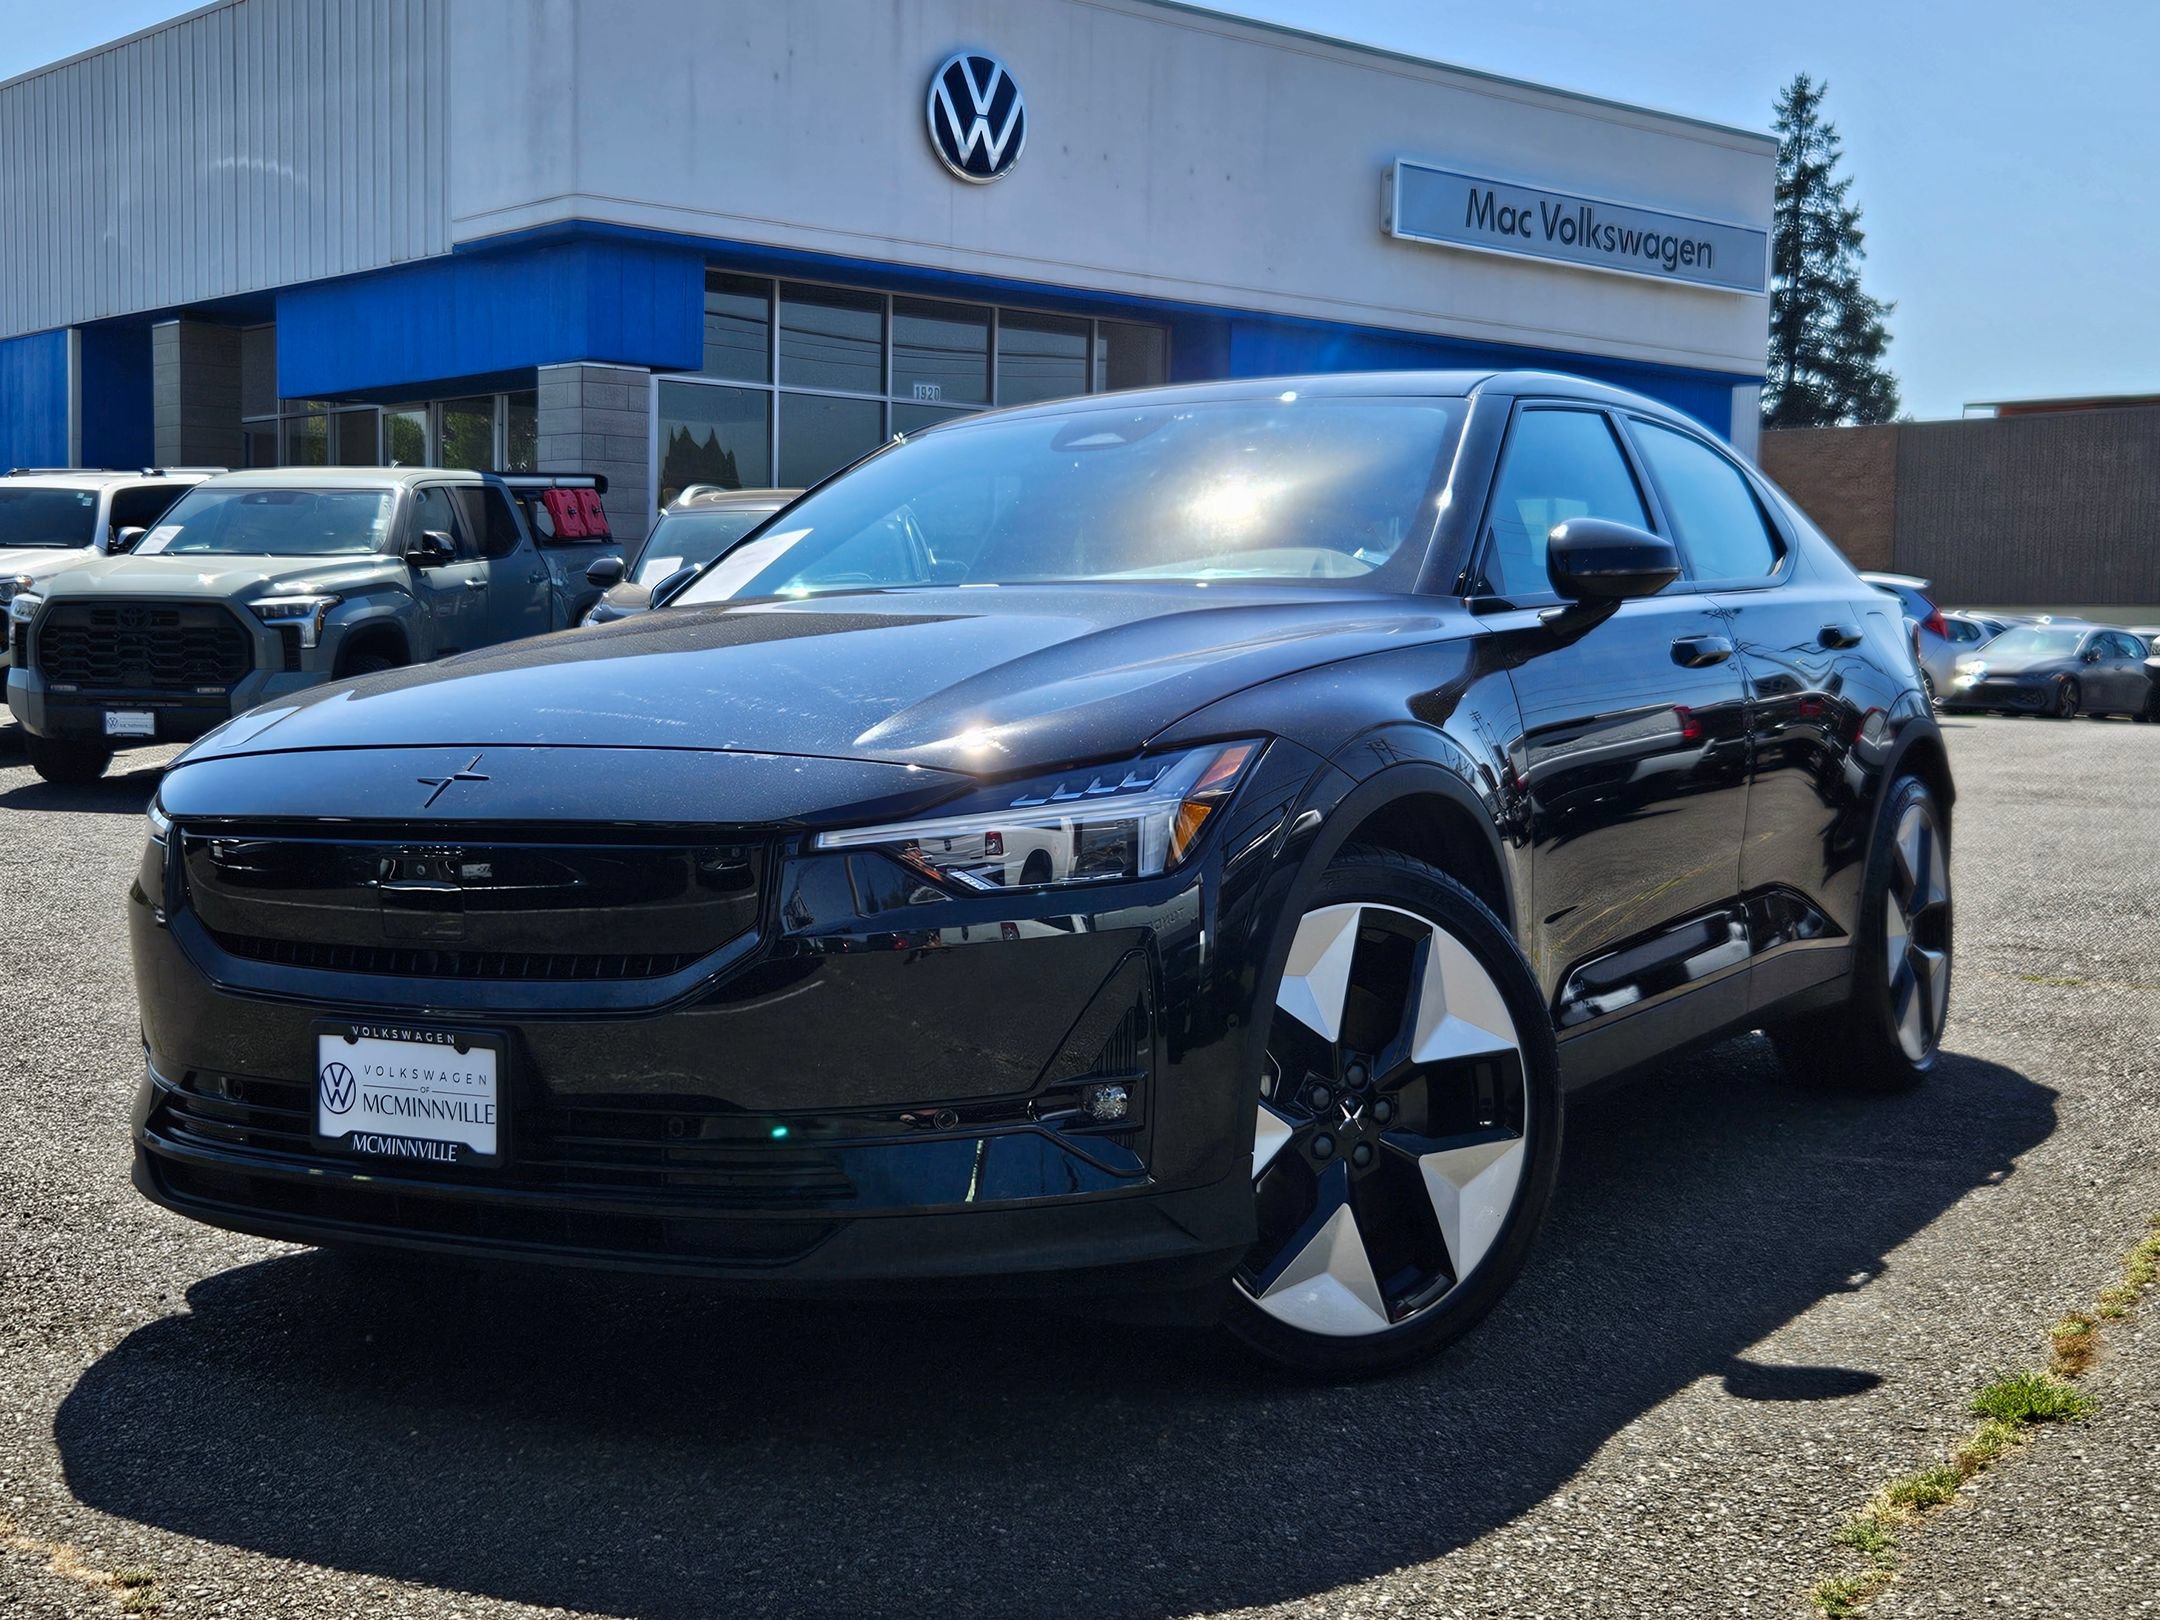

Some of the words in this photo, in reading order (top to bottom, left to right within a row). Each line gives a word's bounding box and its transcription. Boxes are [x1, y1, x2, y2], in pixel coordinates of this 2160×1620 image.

[930, 53, 1026, 183] VW
[1464, 187, 1532, 239] Mac
[1539, 201, 1713, 273] Volkswagen
[914, 384, 941, 401] 1920
[352, 1025, 455, 1044] VOLKSWAGEN
[320, 1062, 356, 1115] VW
[364, 1064, 487, 1086] VOLKSWAGEN
[419, 1086, 430, 1094] OF
[363, 1092, 496, 1125] MCMINNVILLE
[352, 1133, 458, 1162] MCMINNVILLE
